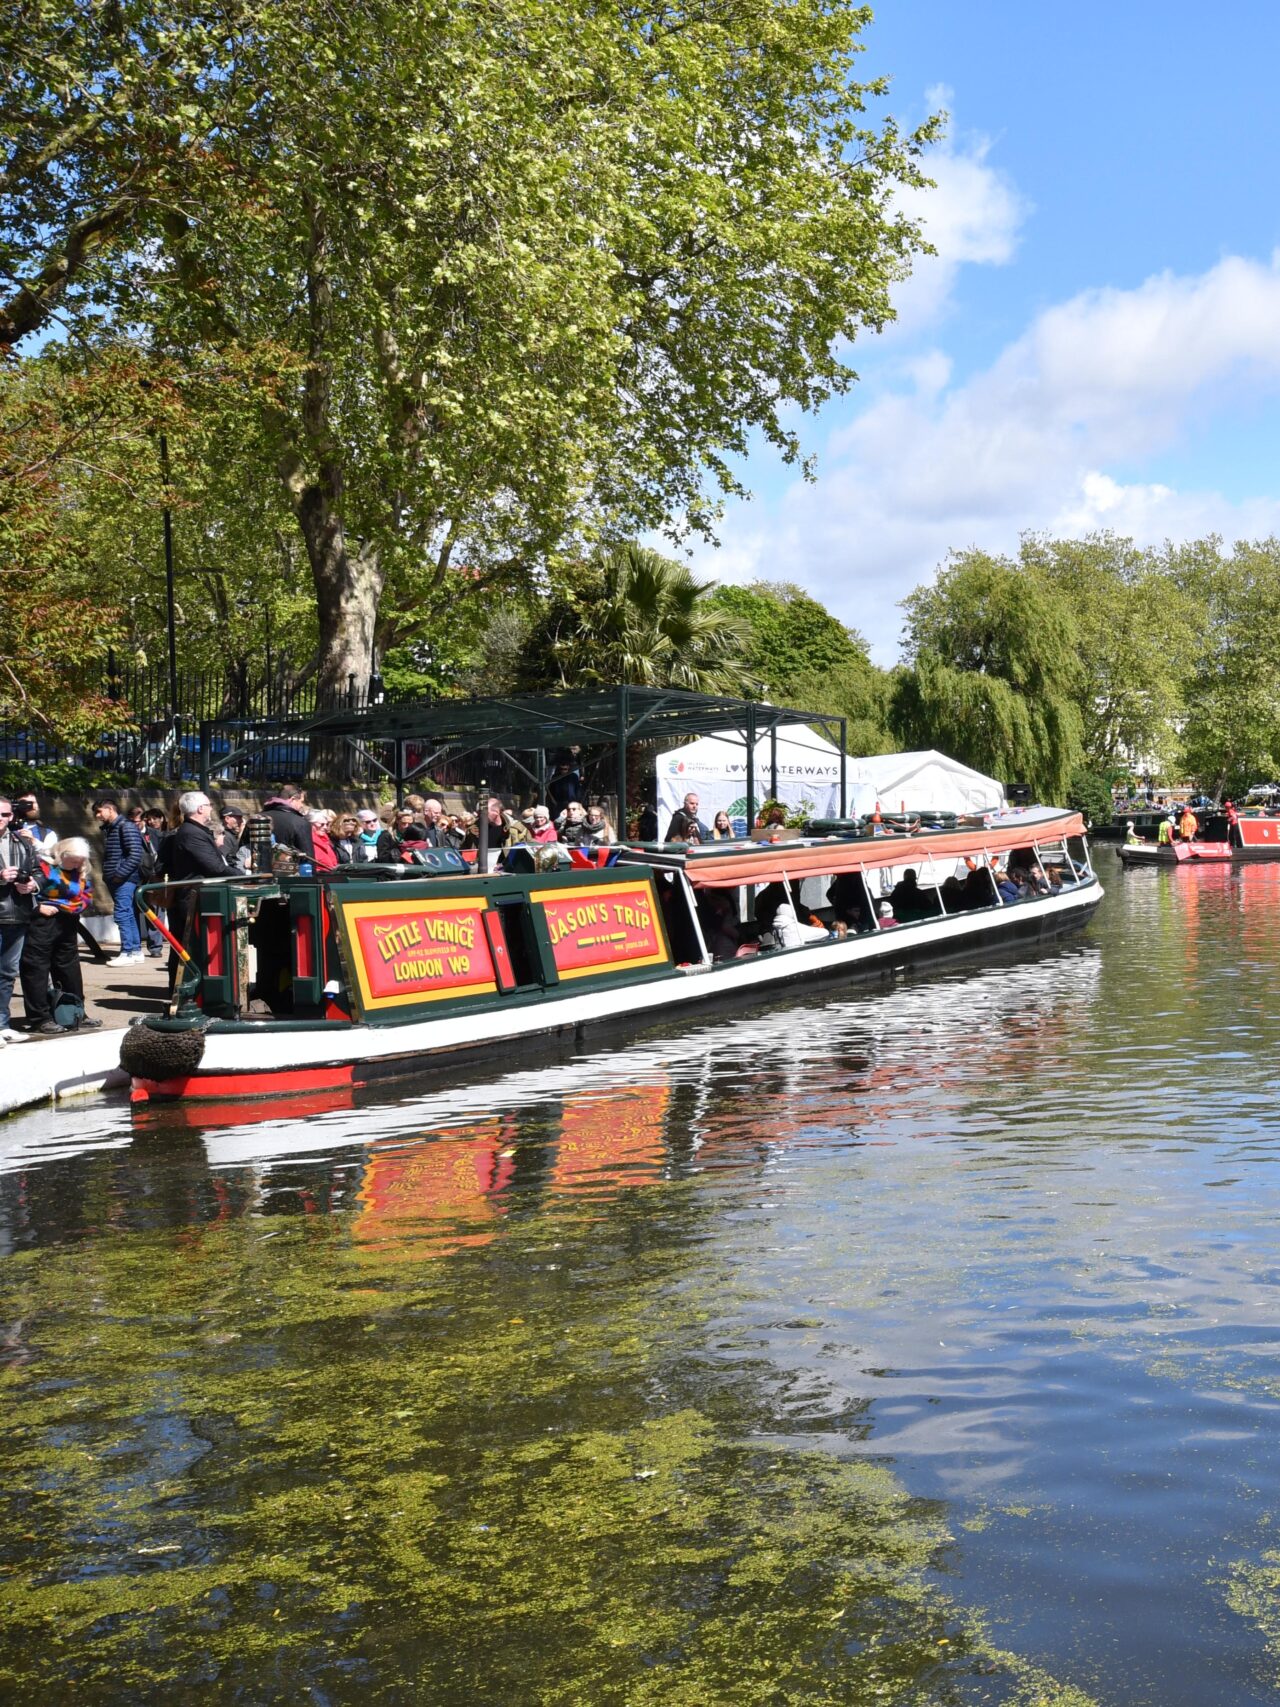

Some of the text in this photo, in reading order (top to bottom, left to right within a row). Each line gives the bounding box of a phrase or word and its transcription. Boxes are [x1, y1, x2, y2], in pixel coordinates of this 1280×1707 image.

[378, 918, 475, 962] LITTLE VENICE
[549, 902, 650, 945] JASON'S TRIP
[394, 955, 471, 982] LONDON W9
